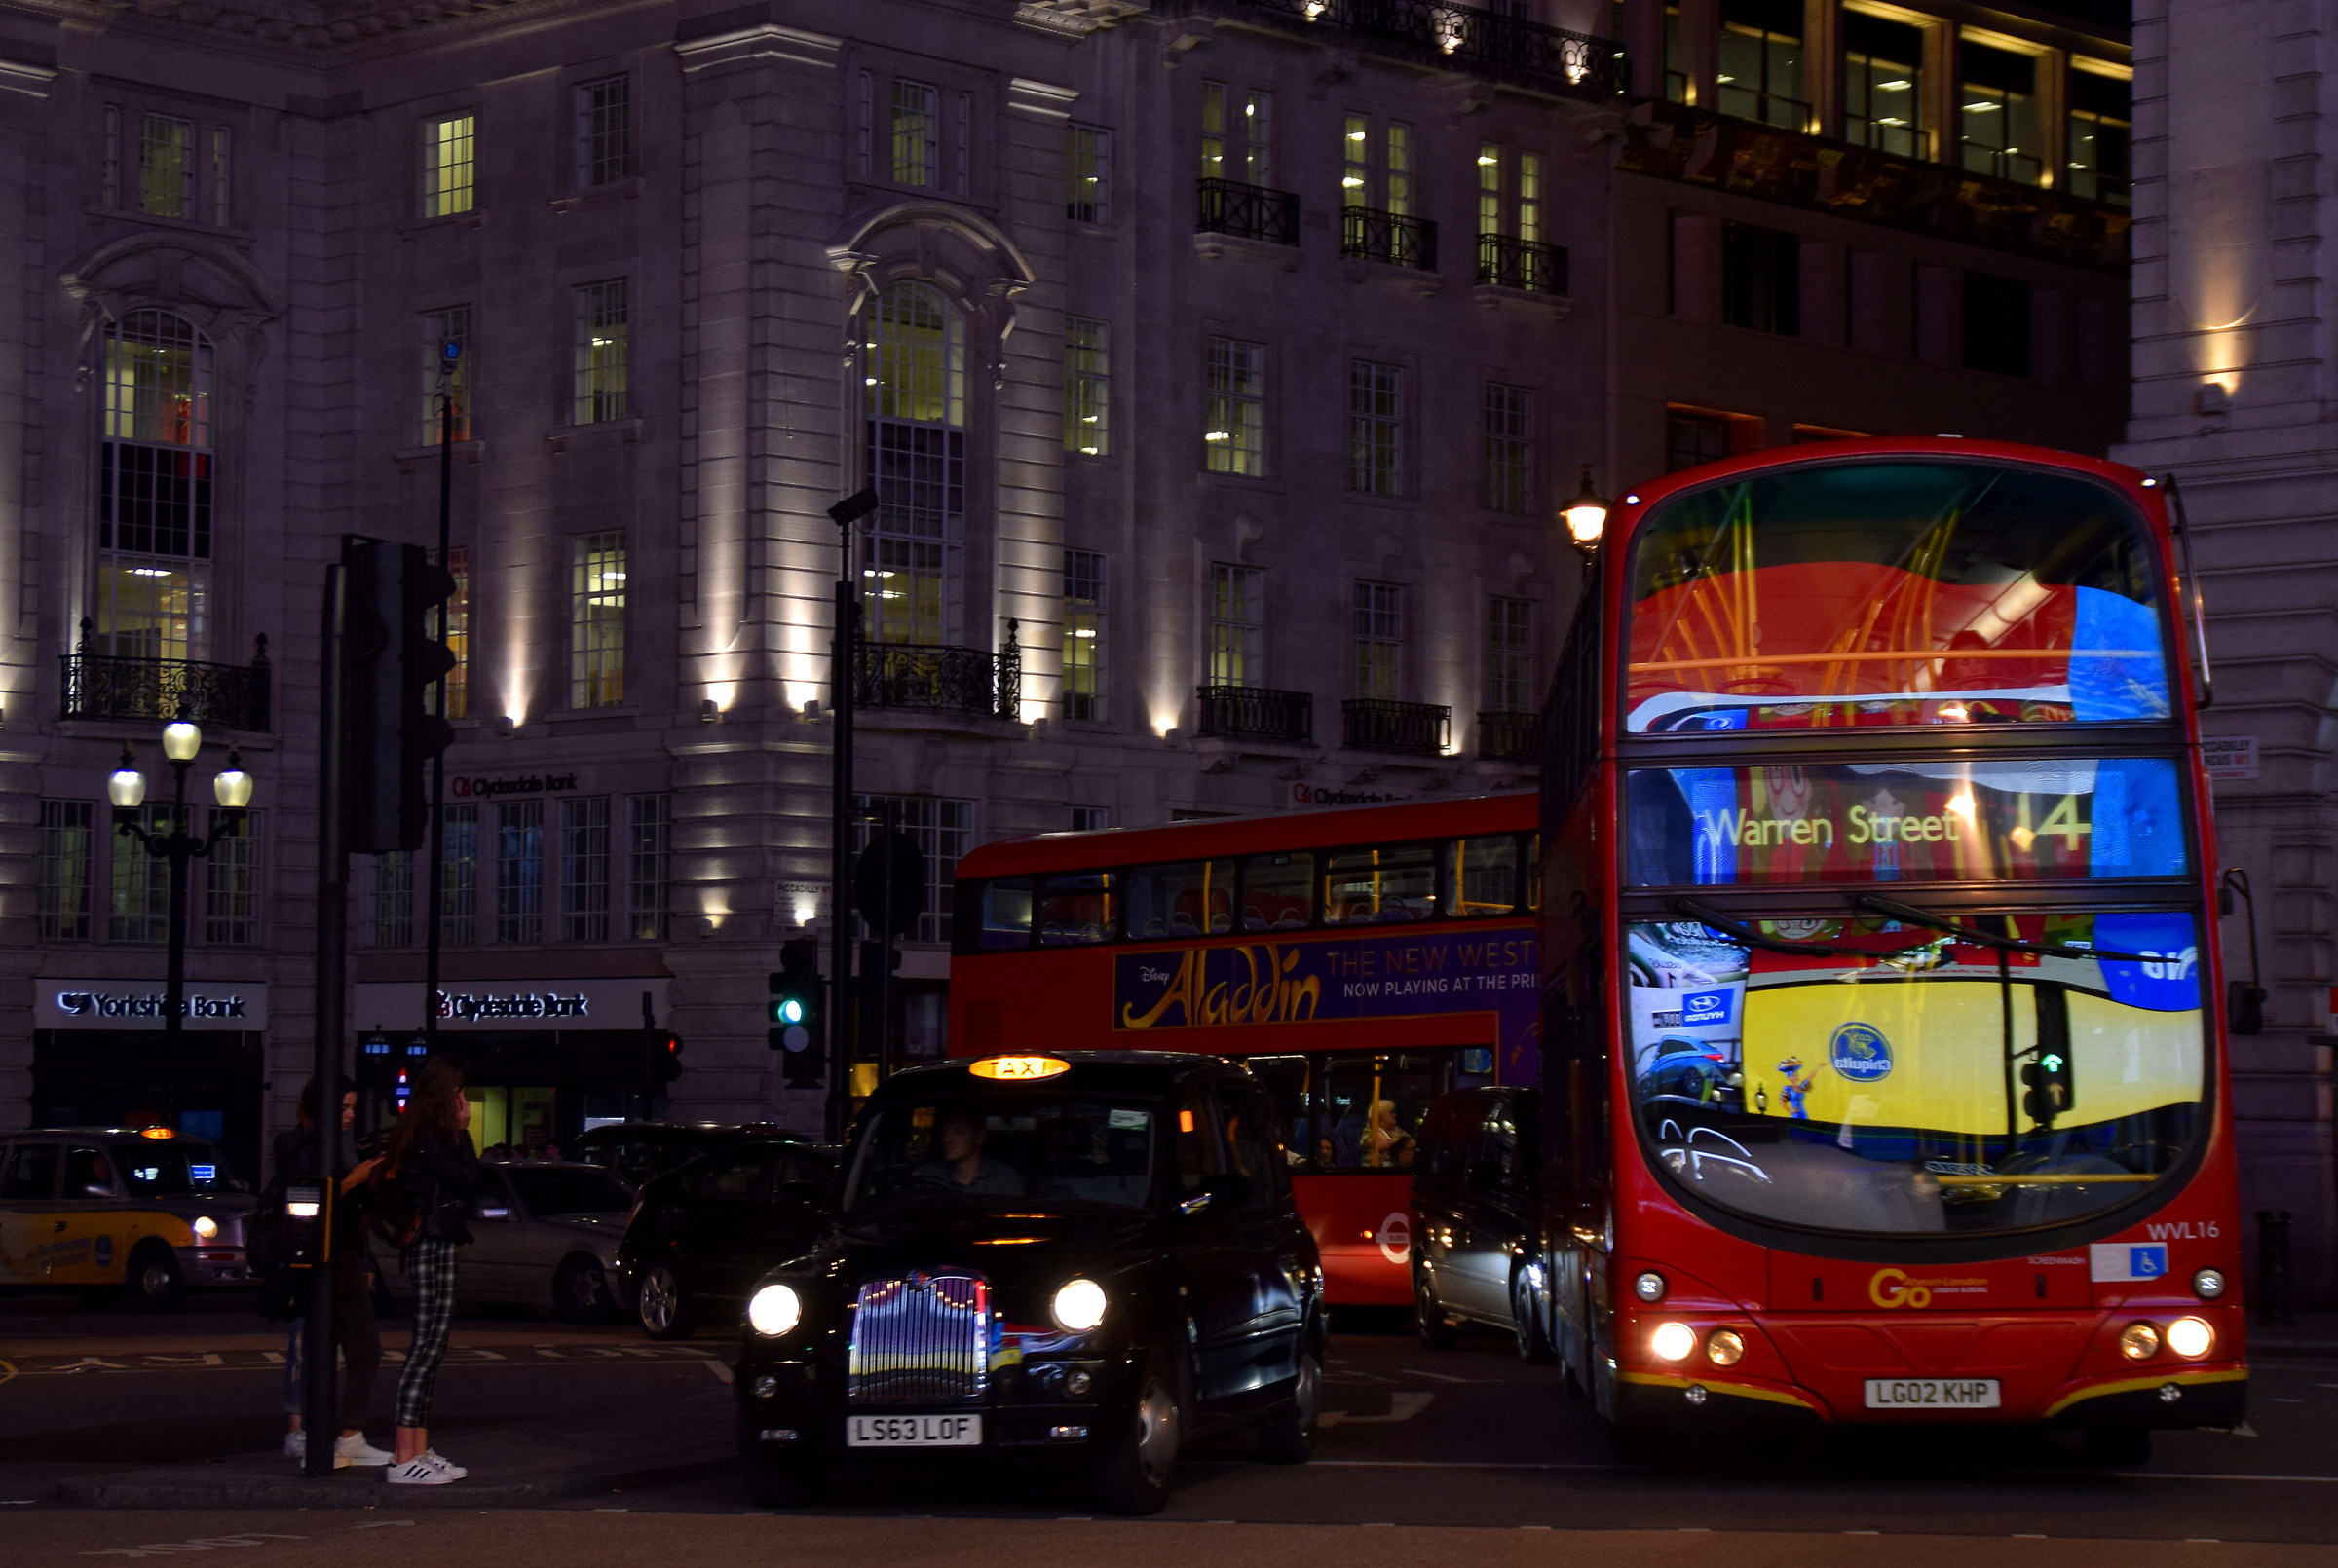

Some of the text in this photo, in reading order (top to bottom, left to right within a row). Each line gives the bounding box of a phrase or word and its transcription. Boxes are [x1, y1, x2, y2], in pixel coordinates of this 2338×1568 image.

[473, 772, 578, 799] Clydesdale Bank
[1706, 804, 1961, 846] Warren Street
[778, 883, 819, 893] PICCADILLY
[1326, 940, 1534, 978] THE NEW WEST
[1122, 944, 1321, 1028] Aladdin
[1344, 973, 1535, 998] NOW PLAYING AT THE PRI
[94, 993, 246, 1018] Yorkshie Bank
[453, 993, 588, 1022] Clydesdale Bank
[990, 1061, 1046, 1076] TAXI
[2146, 1221, 2220, 1241] WVL16
[1868, 1267, 1932, 1309] Go
[1877, 1383, 1988, 1403] LG02 KHP
[857, 1418, 968, 1440] LS63 LOF
